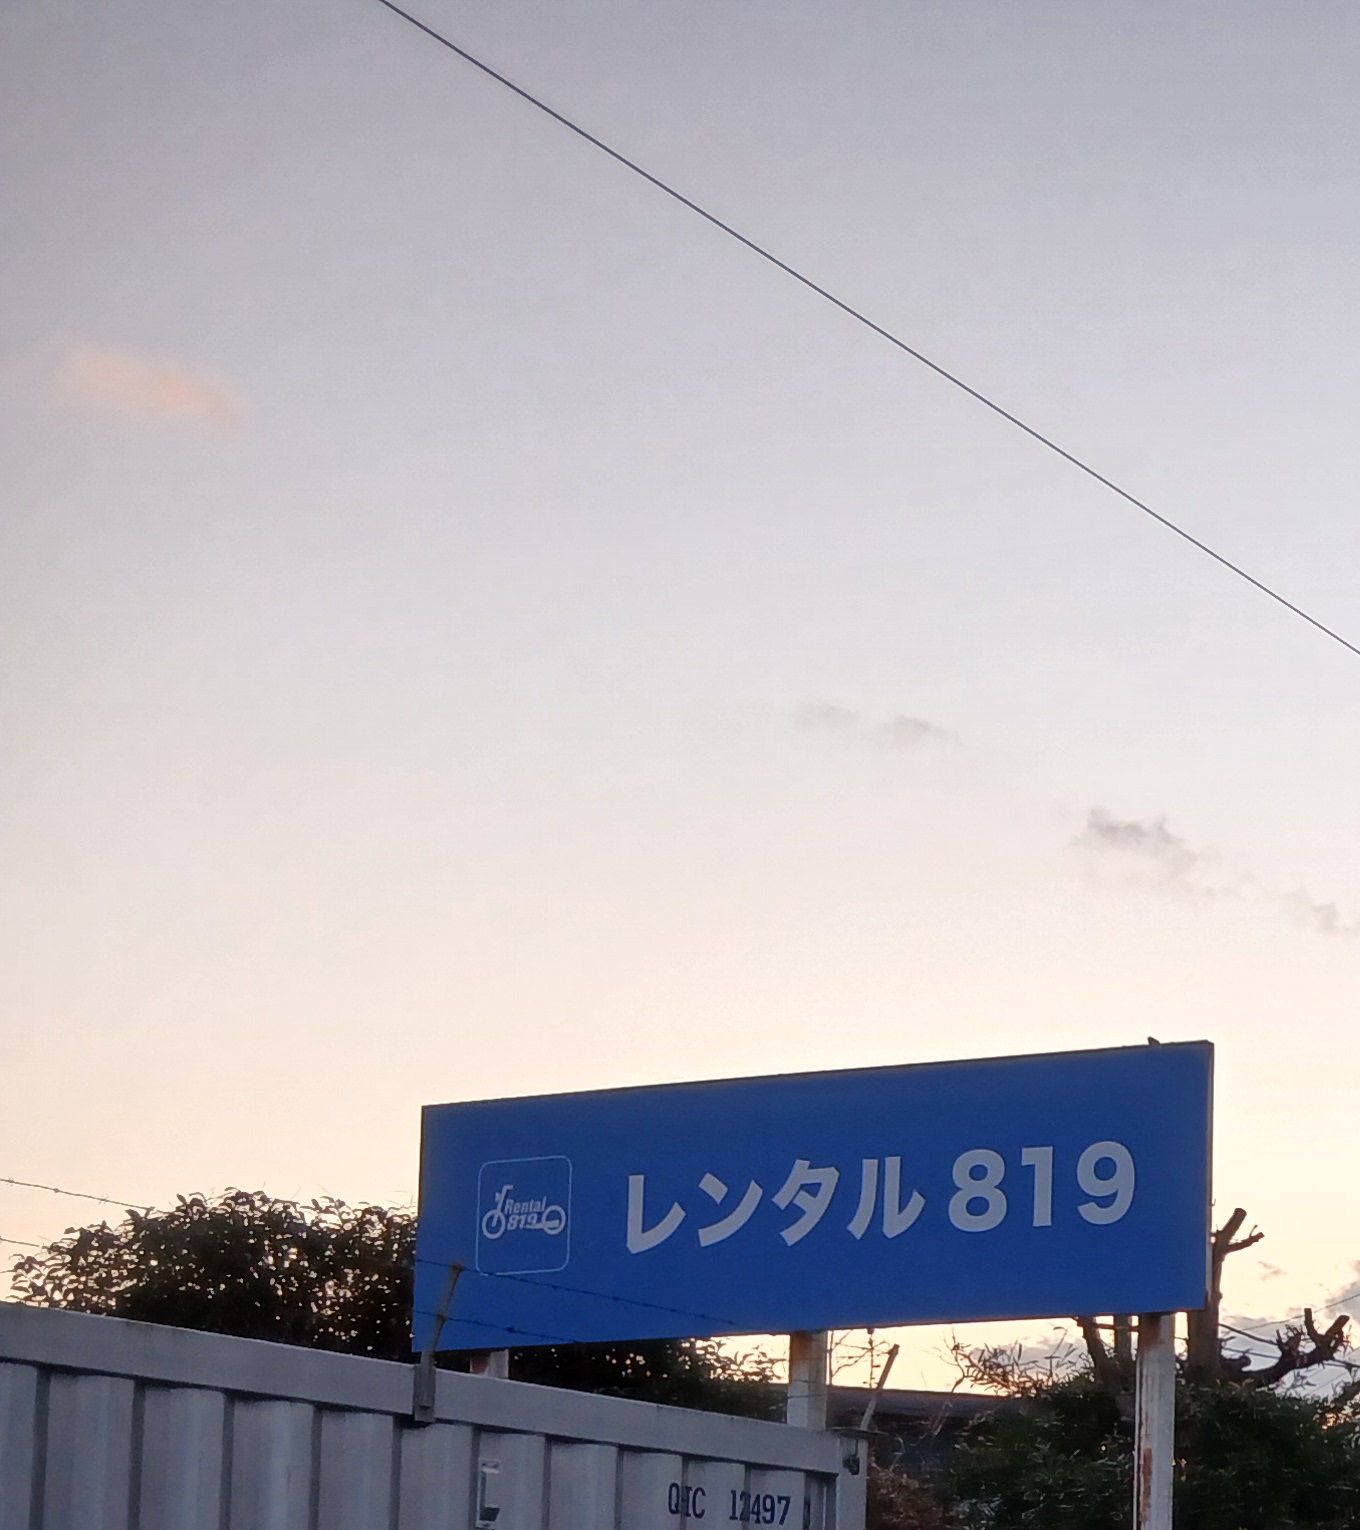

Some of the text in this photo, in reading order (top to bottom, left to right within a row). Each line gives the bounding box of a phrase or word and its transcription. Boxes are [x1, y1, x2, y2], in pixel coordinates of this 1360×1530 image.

[504, 1195, 548, 1215] Rental
[626, 1140, 1136, 1255] レンタル819
[507, 1213, 539, 1231] 819
[729, 1489, 792, 1526] 12497
